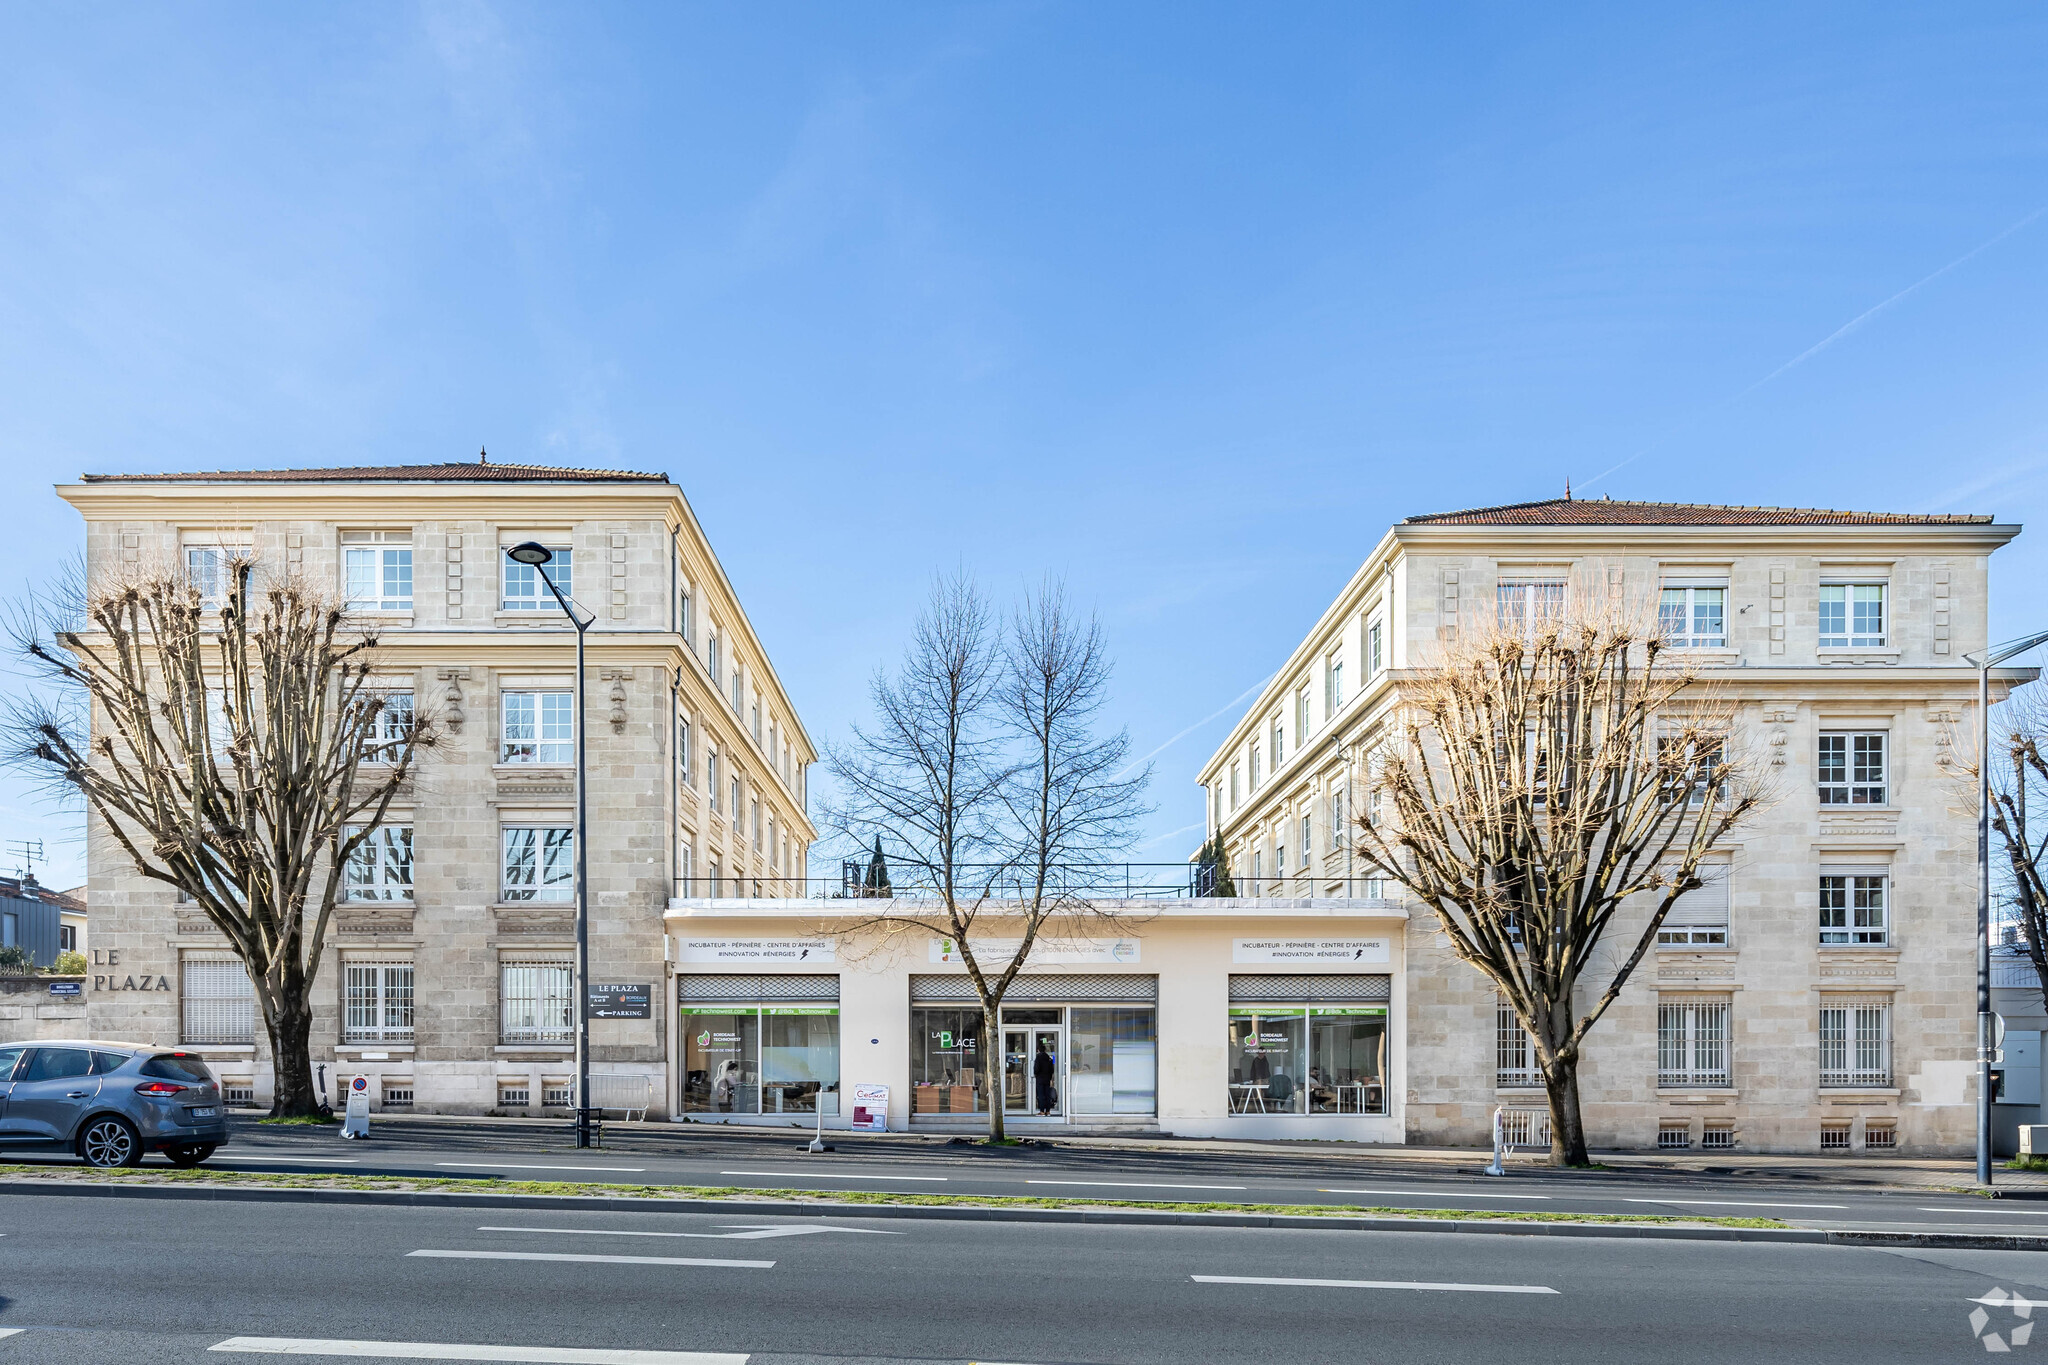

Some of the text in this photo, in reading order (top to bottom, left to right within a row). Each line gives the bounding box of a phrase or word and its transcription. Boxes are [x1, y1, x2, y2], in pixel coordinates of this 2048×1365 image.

[93, 950, 119, 966] LE
[987, 946, 1011, 954] fabrique
[94, 975, 171, 991] PLAZA
[941, 1032, 976, 1048] PLACE
